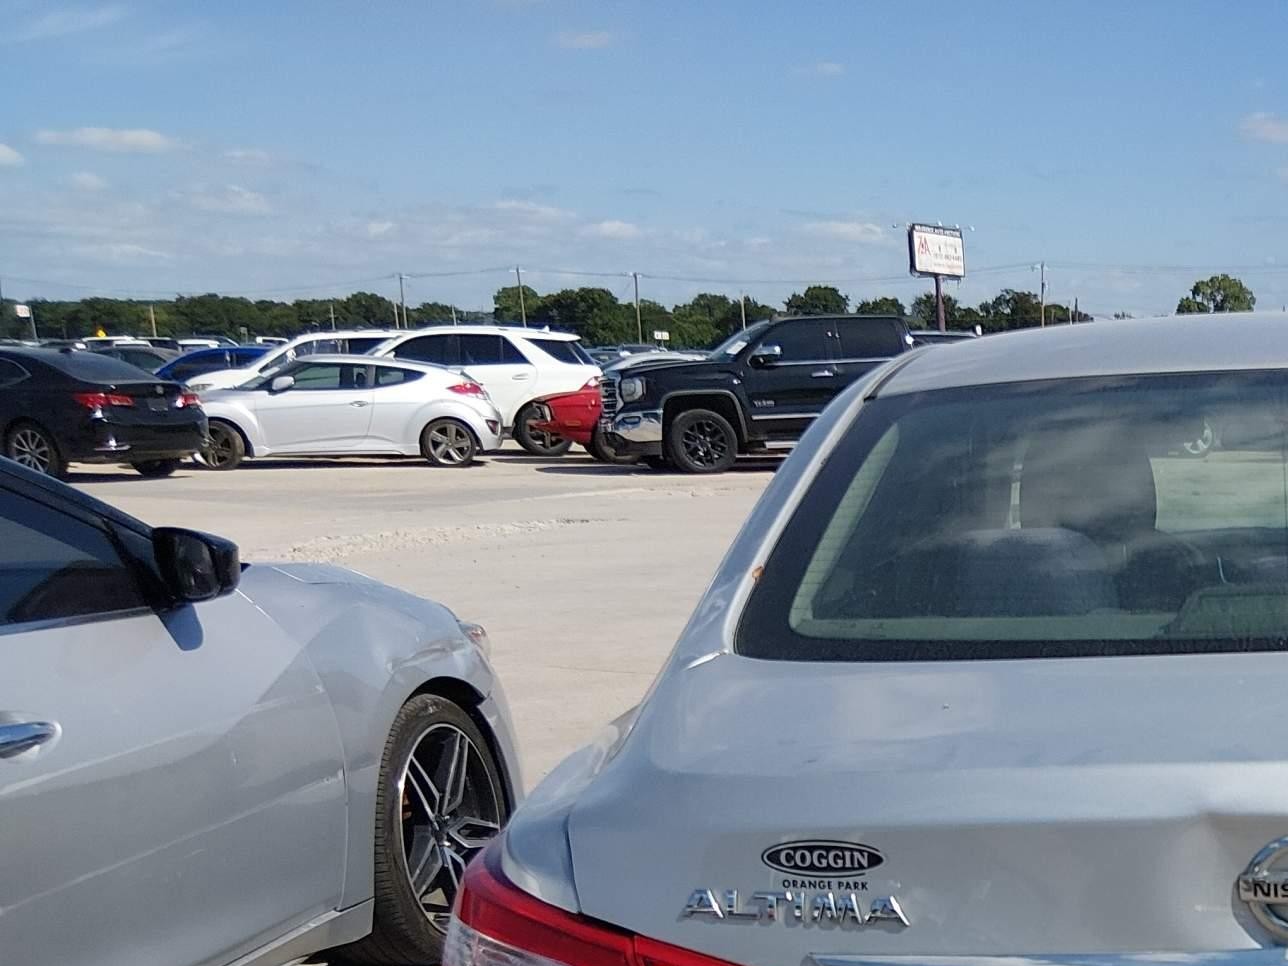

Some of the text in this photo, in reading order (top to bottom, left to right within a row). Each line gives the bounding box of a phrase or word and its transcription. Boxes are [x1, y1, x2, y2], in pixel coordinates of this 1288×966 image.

[779, 849, 869, 868] COGGIN
[782, 879, 868, 891] ORANGE PARK
[683, 887, 911, 927] ALTIMA
